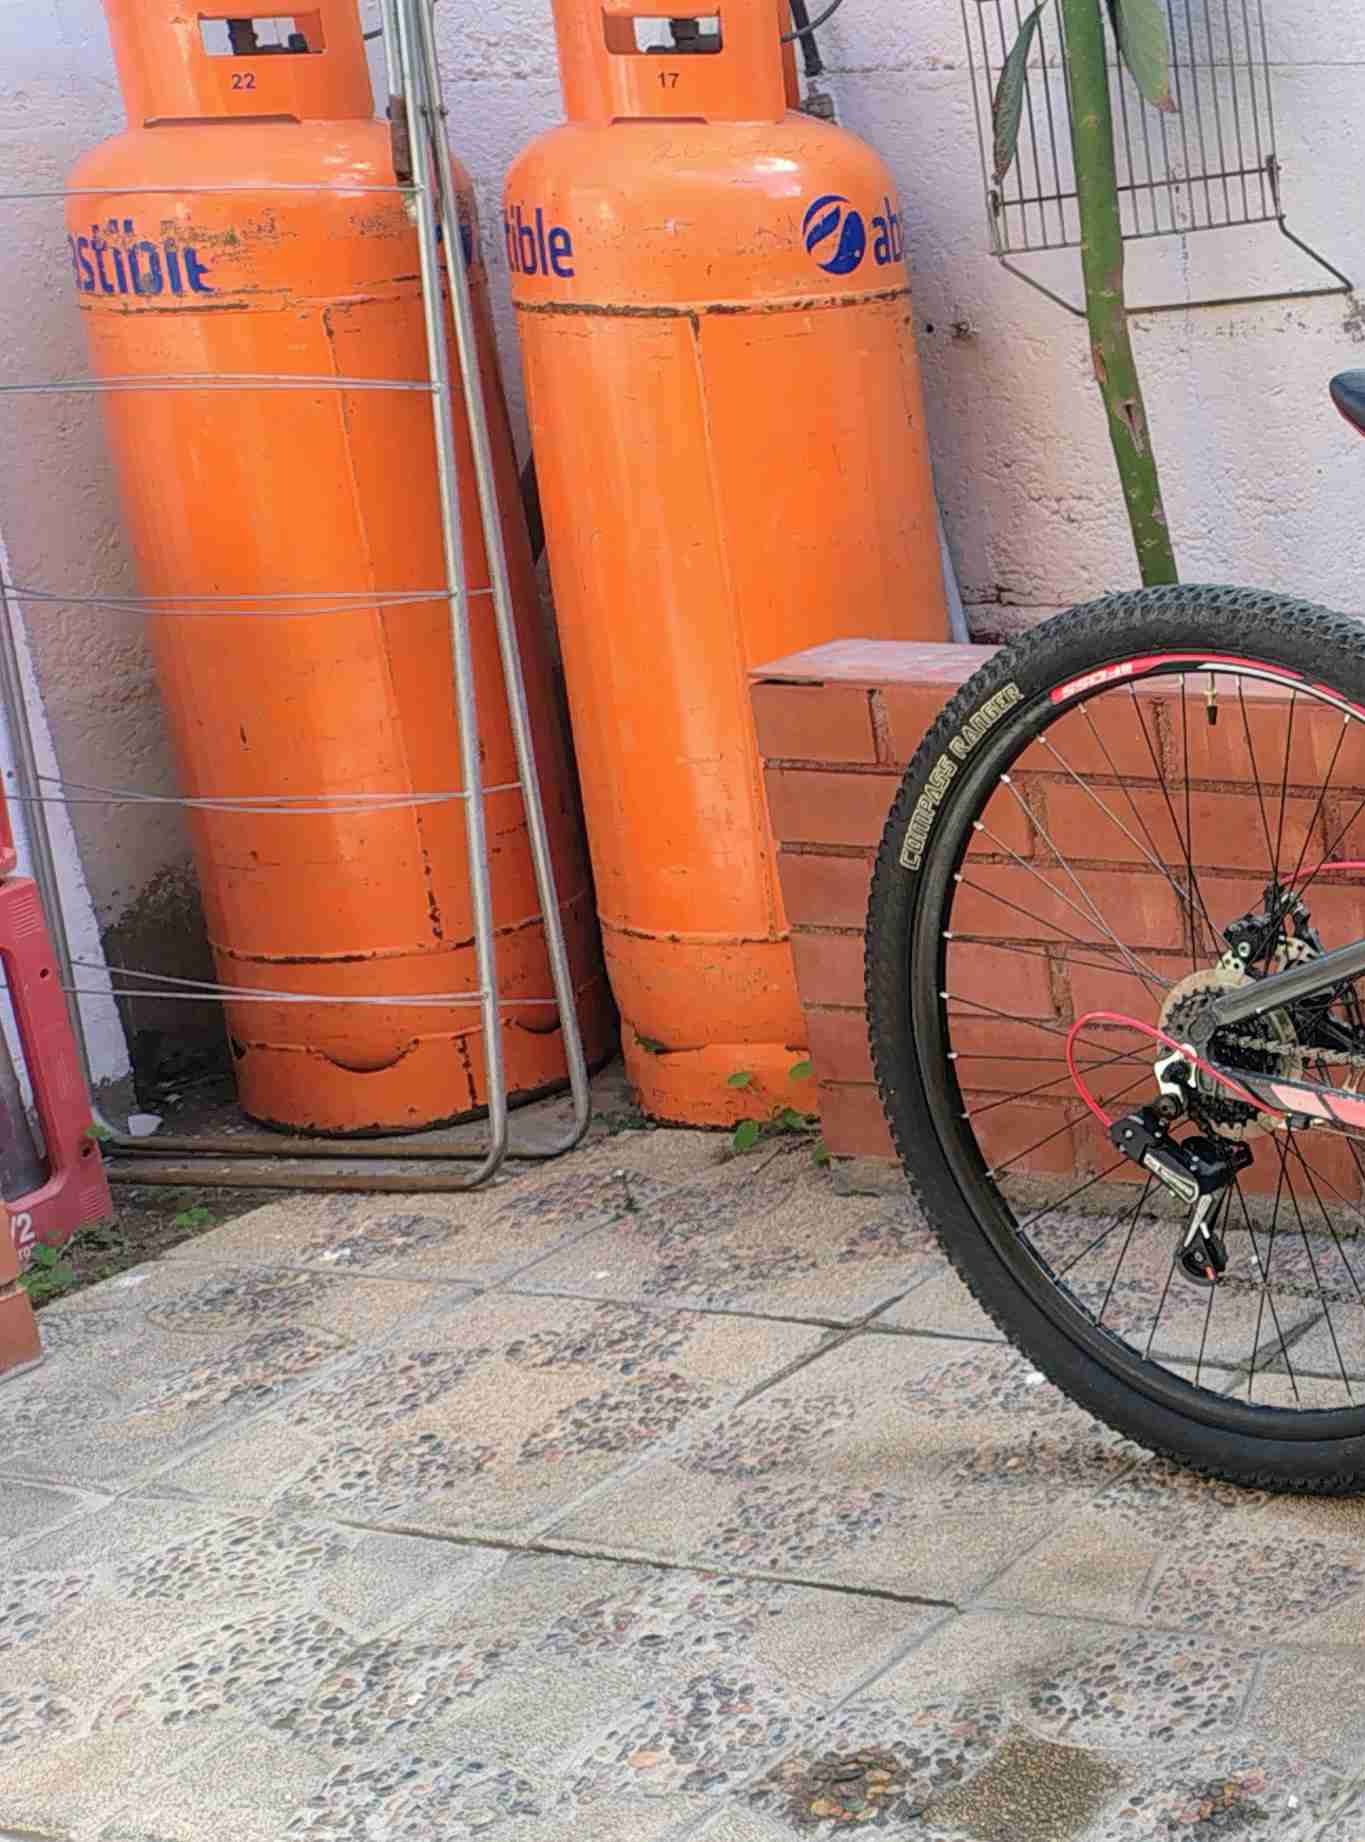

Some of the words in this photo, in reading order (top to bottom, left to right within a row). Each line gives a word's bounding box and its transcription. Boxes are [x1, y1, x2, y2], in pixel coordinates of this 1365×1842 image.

[231, 73, 256, 90] 22
[657, 72, 680, 89] 17
[900, 753, 958, 870] COMPASS
[948, 682, 1025, 760] RANGER
